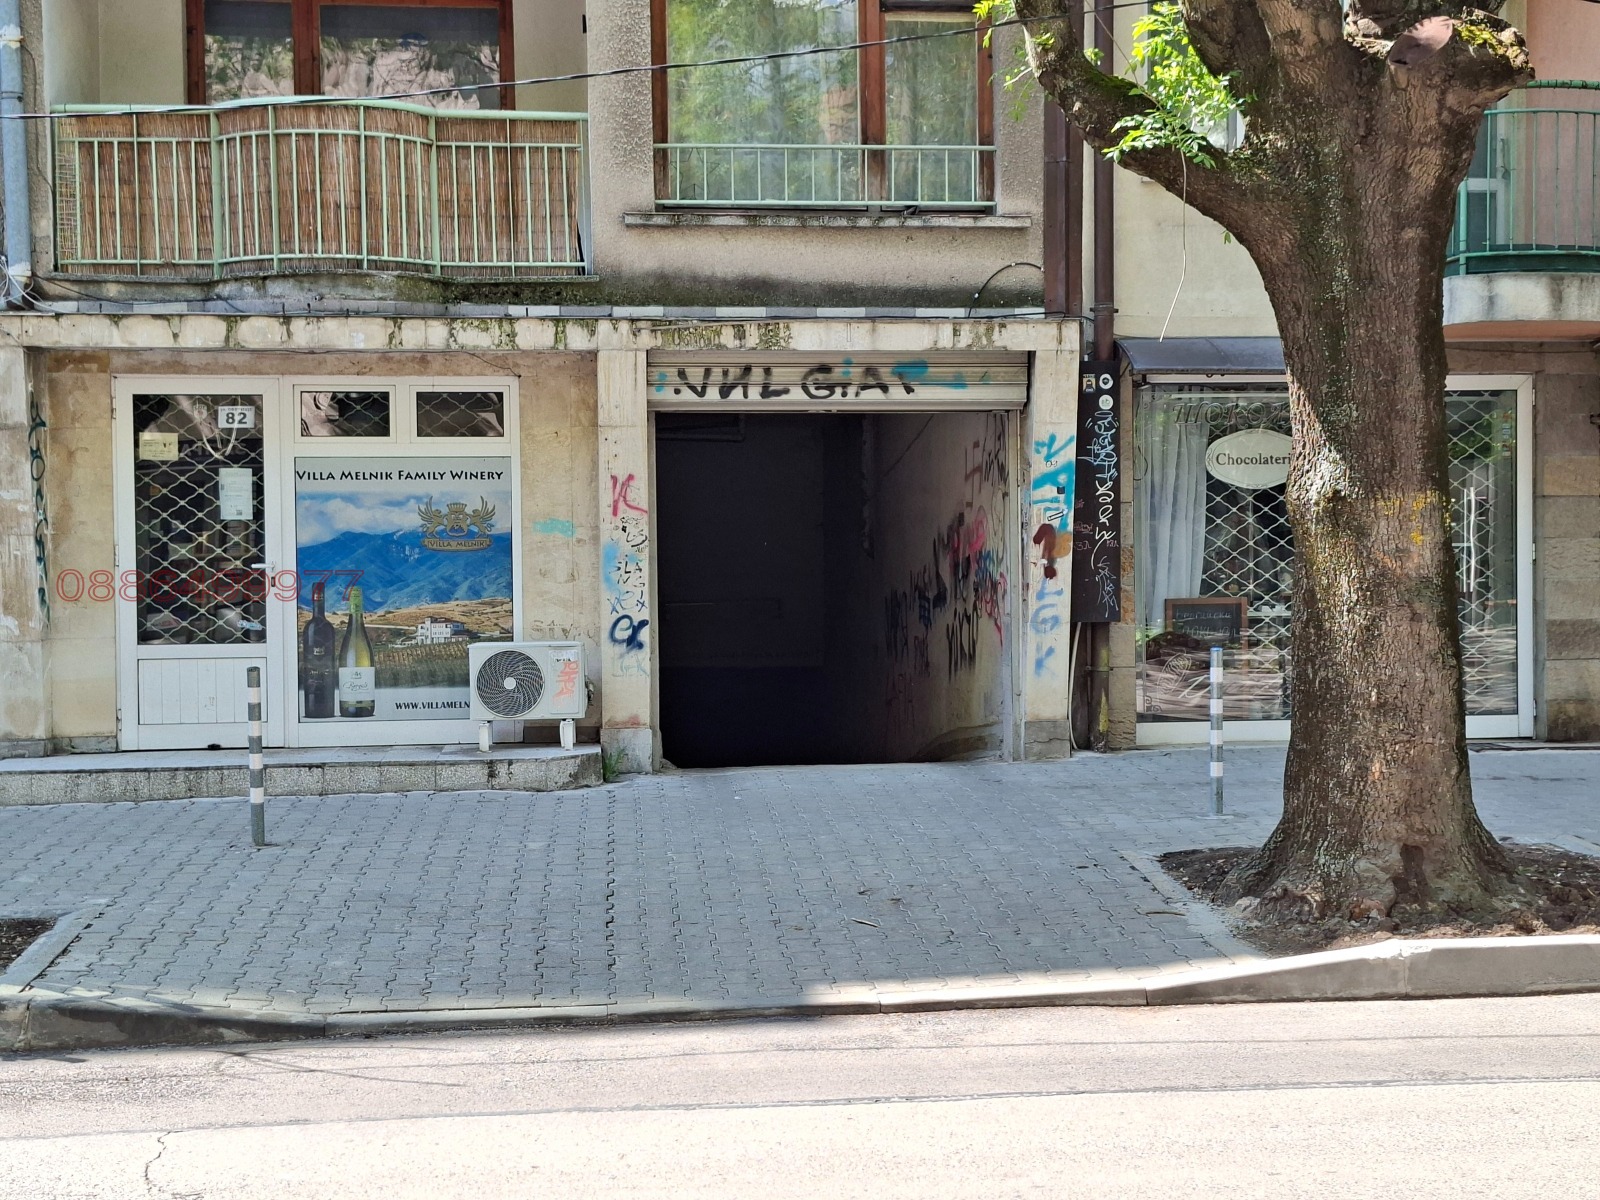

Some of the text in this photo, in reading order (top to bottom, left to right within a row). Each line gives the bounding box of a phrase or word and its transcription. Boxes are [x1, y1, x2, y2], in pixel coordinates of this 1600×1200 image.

[226, 412, 247, 425] 82
[296, 470, 504, 480] VILLA MELNIK FAMILY WINERY
[429, 540, 485, 548] VILLA MELNIK
[395, 701, 470, 710] WWW.VILLAMELN
